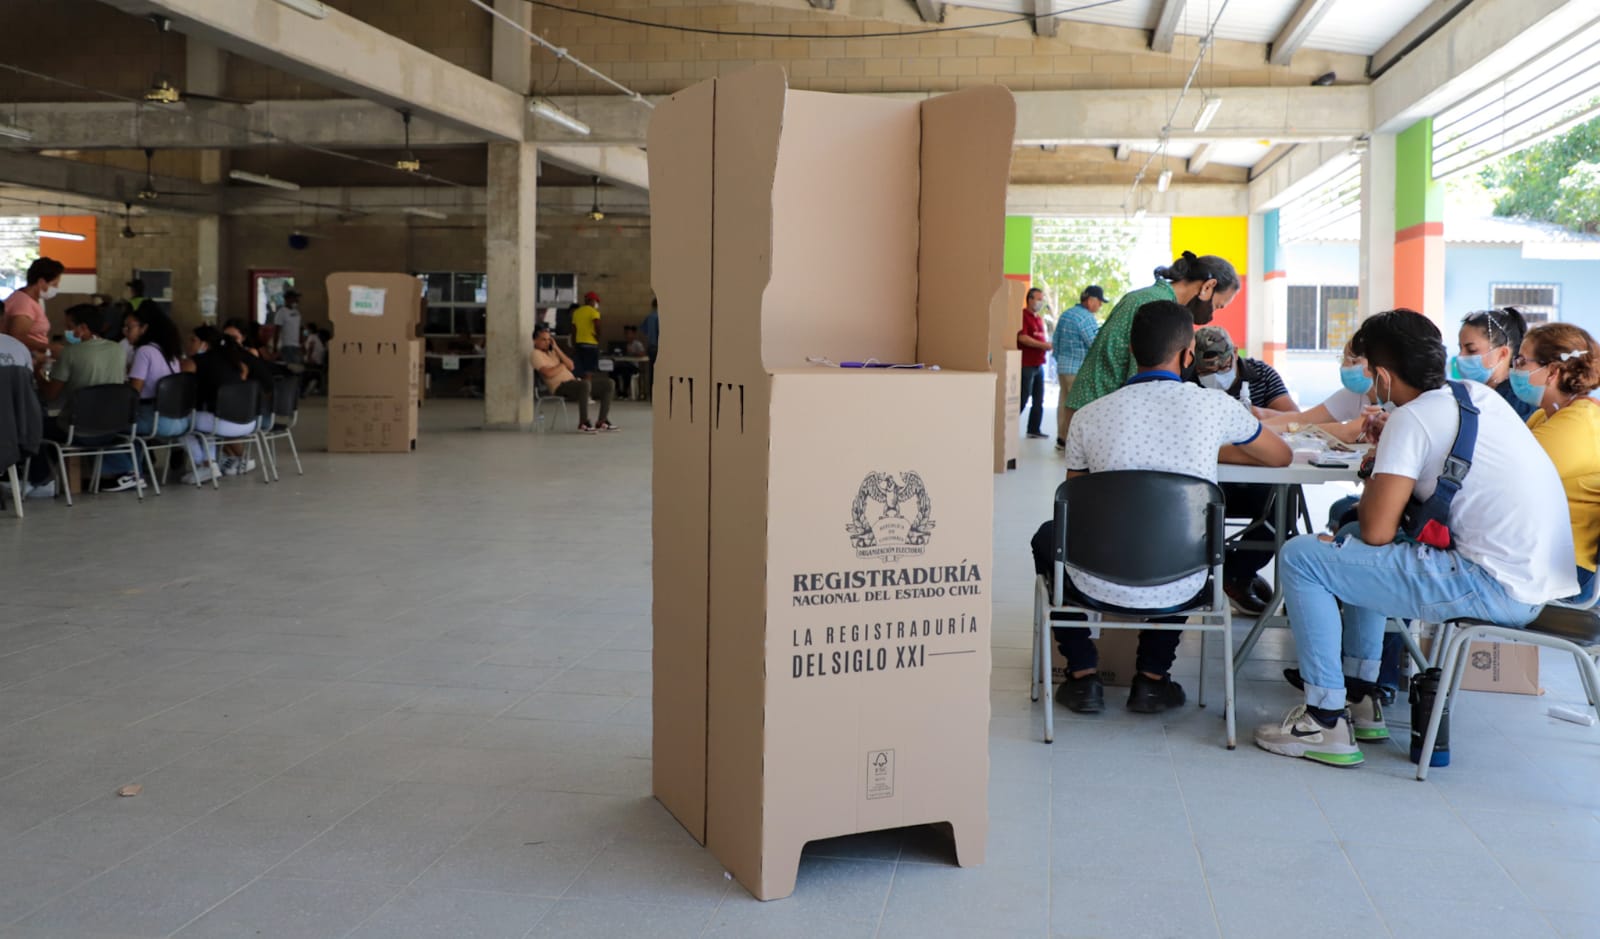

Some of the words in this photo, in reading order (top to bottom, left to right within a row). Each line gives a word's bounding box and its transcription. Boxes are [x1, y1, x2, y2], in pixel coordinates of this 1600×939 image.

[793, 559, 981, 592] REGISTRADURÍA
[792, 592, 860, 607] NACIONAL
[864, 590, 891, 602] DEL
[895, 587, 945, 600] ESTADO
[949, 584, 981, 596] CIVIL
[793, 628, 812, 647] LA
[826, 613, 978, 645] REGISTRADURÍA
[792, 652, 826, 679] DEL
[832, 648, 887, 675] SIGLO
[896, 644, 925, 669] XXI
